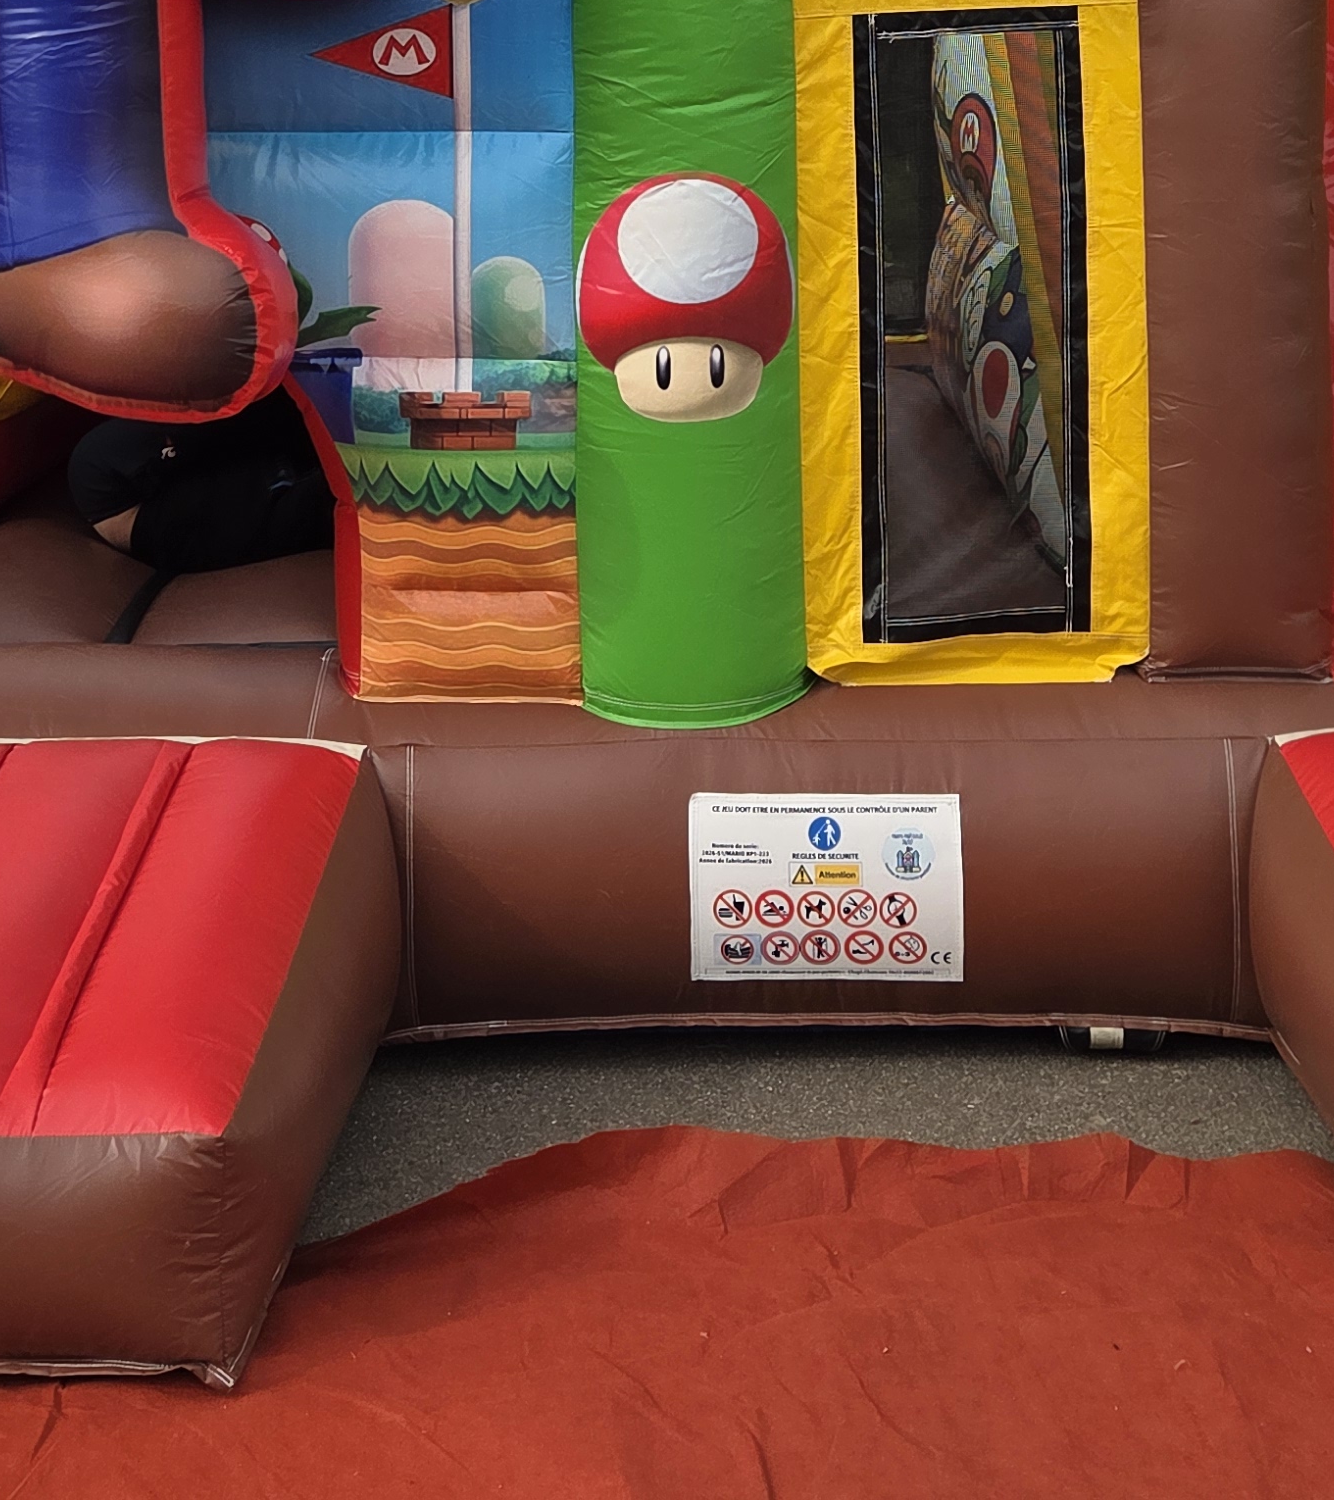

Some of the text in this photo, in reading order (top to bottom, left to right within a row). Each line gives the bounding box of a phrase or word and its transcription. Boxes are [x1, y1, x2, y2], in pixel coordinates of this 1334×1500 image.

[378, 32, 431, 67] M
[712, 805, 720, 813] CE
[722, 805, 733, 813] JEU
[780, 806, 826, 814] PERMANENCE
[818, 852, 826, 860] DE
[818, 870, 856, 879] Attention
[930, 951, 952, 965] CE
